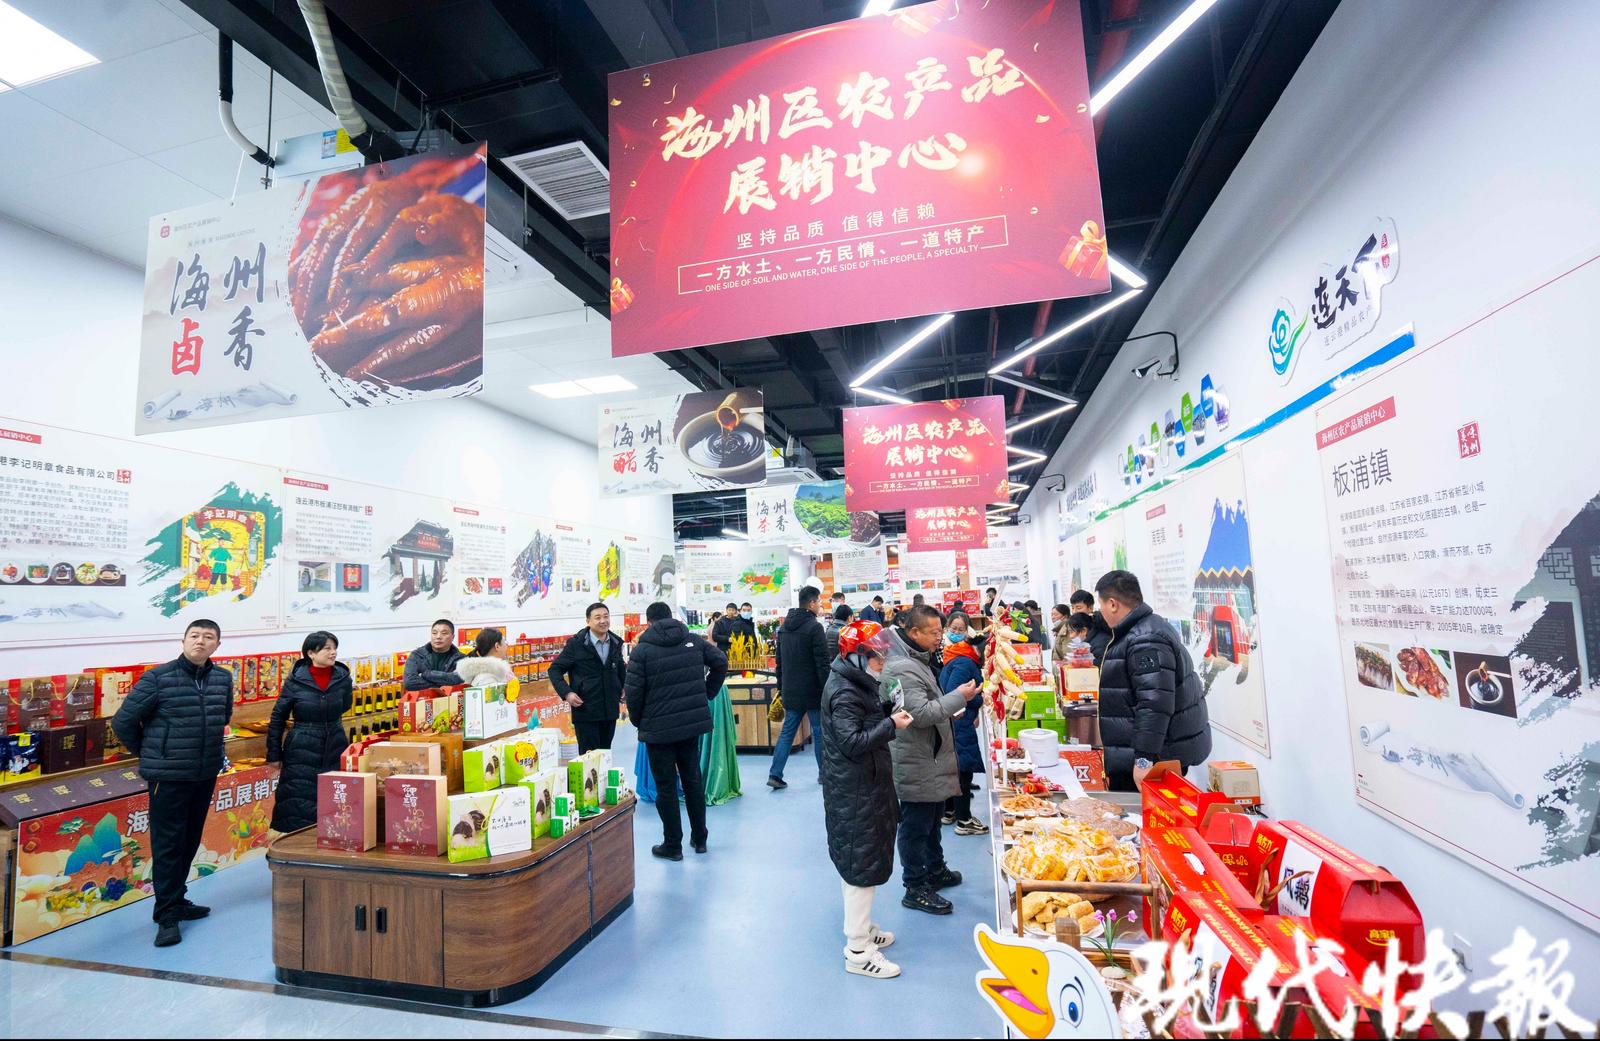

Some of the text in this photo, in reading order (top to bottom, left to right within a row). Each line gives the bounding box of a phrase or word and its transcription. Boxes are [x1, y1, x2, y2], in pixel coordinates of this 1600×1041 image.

[660, 47, 1026, 162] 海州区农产品
[723, 132, 968, 215] 展销中心
[737, 203, 936, 249] 坚持品质 值得信赖
[696, 224, 985, 281] 一方水土、一方民情、一道特产
[705, 244, 980, 292] ONE SIDE OF SOIL AND WATER, ONE SIDE OF THE PEOPLE, A SPECIALTY
[170, 242, 267, 316] 海州
[171, 305, 266, 376] 卤香
[614, 419, 662, 448] 海州
[862, 418, 987, 444] 海州区农产品
[1321, 405, 1386, 445] 海州区农产品展销中心
[613, 446, 664, 474] 醋香
[885, 444, 968, 466] 展销中心
[1333, 448, 1392, 497] 板浦镇
[757, 499, 787, 516] 海州
[757, 515, 788, 534] 茶香
